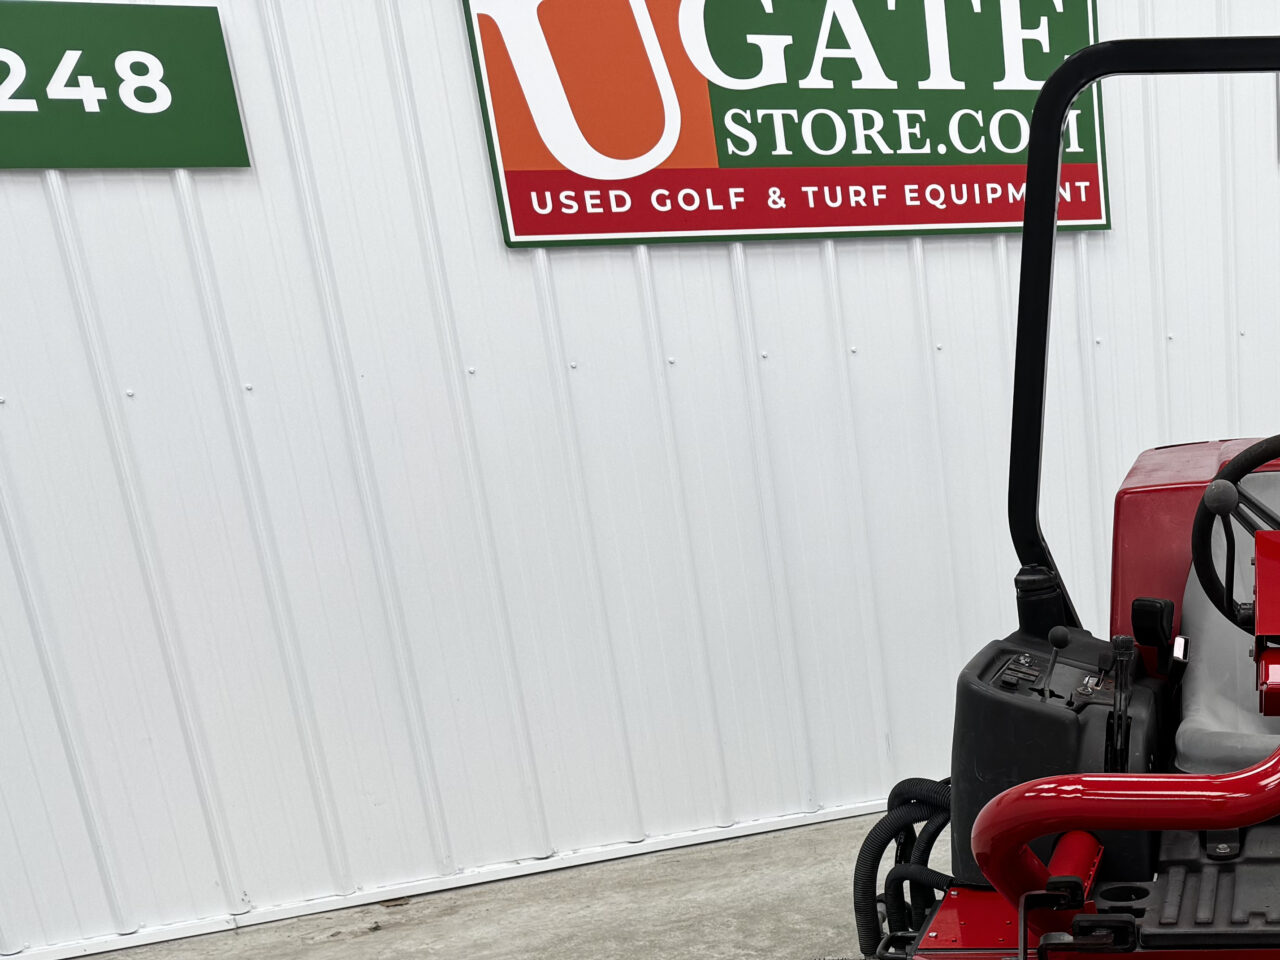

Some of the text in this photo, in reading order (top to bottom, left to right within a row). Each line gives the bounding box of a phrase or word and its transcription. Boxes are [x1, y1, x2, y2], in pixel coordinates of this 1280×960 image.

[0, 48, 172, 114] 248
[530, 181, 1091, 215] USED GOLF & TURF EQUIPMNT
